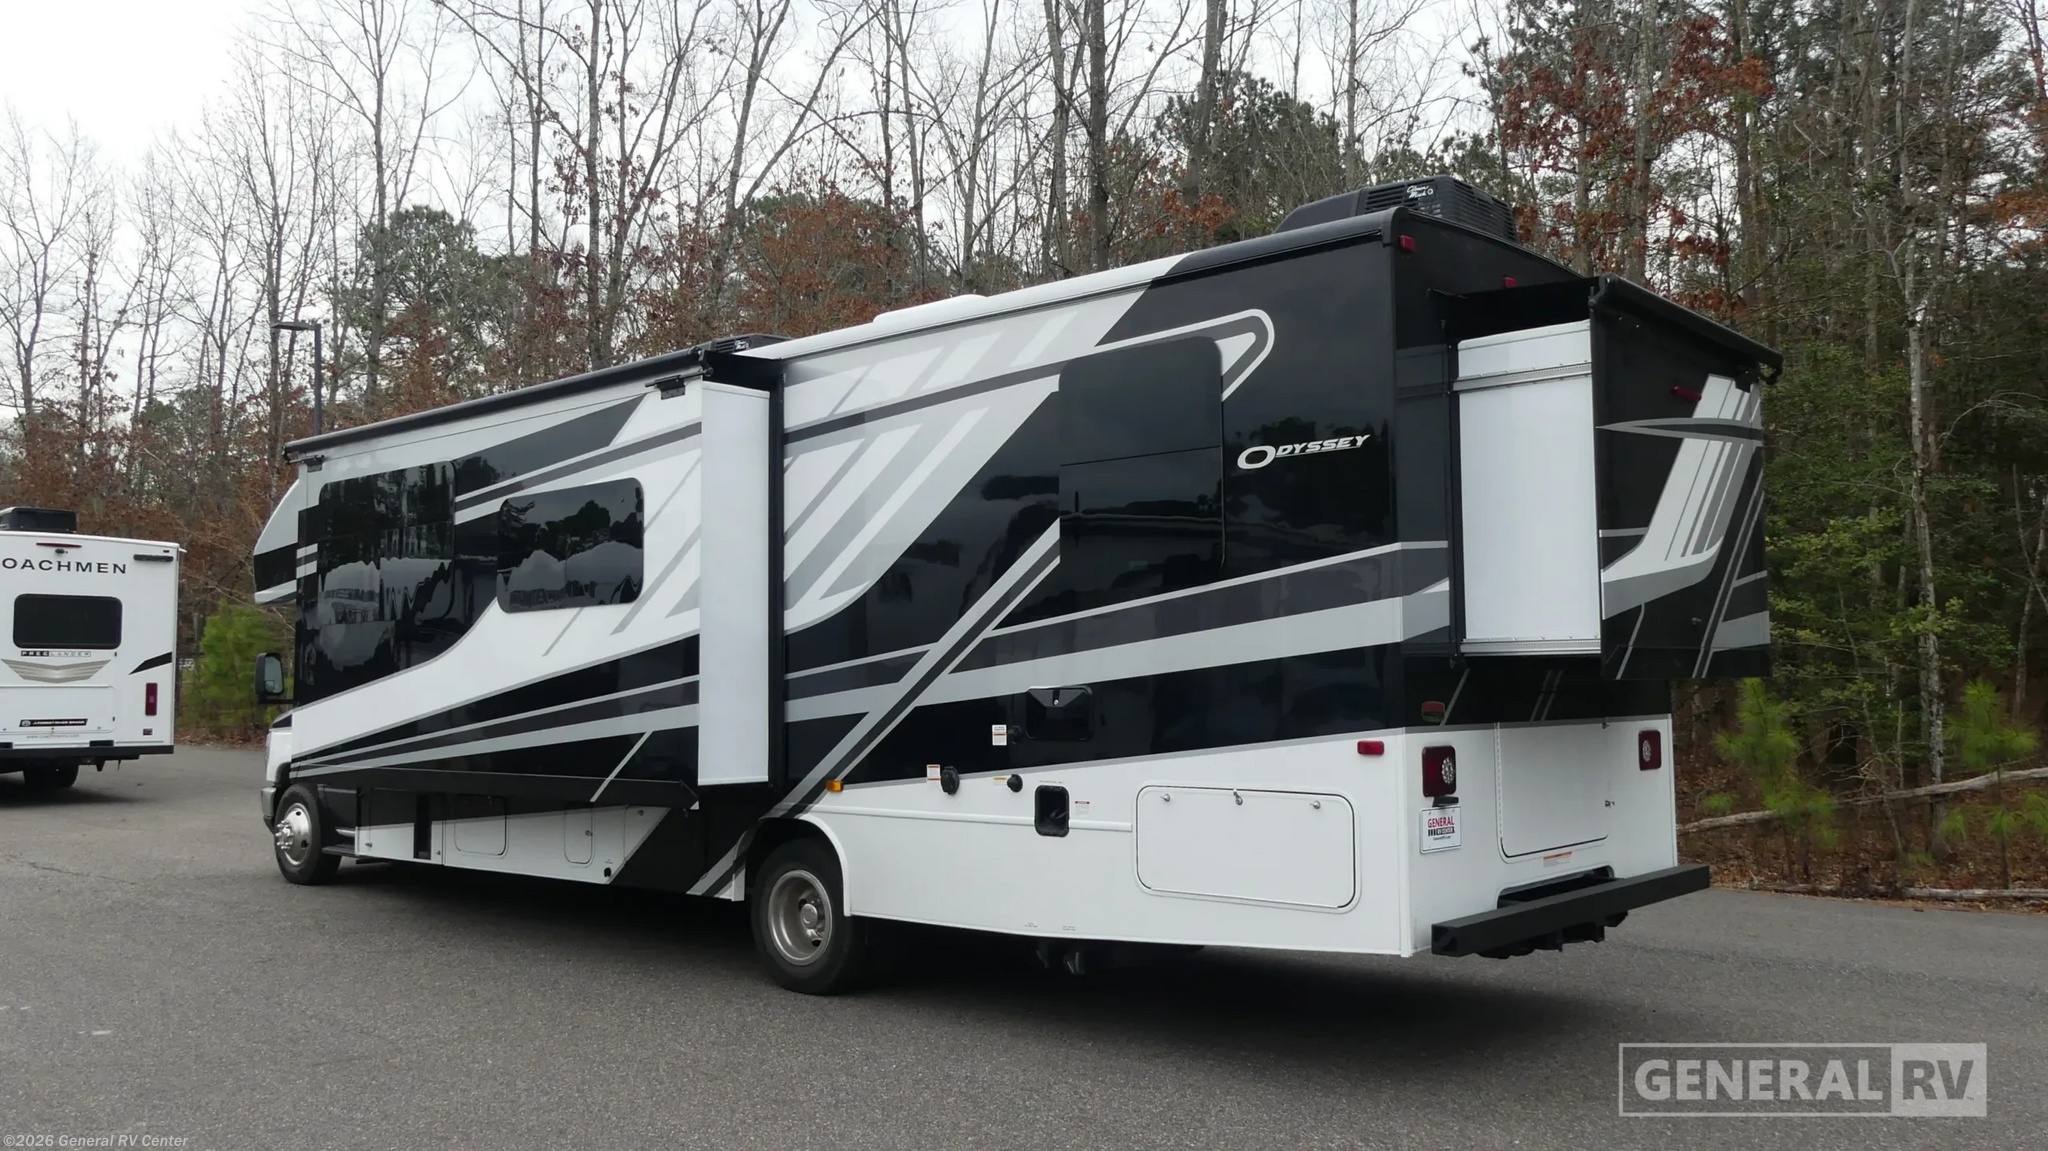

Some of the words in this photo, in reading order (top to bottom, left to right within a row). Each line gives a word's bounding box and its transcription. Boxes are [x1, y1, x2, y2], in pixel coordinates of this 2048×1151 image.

[1237, 434, 1370, 469] ODYSSEY
[2, 557, 126, 575] OACHMEN
[1428, 816, 1454, 828] GENERAL
